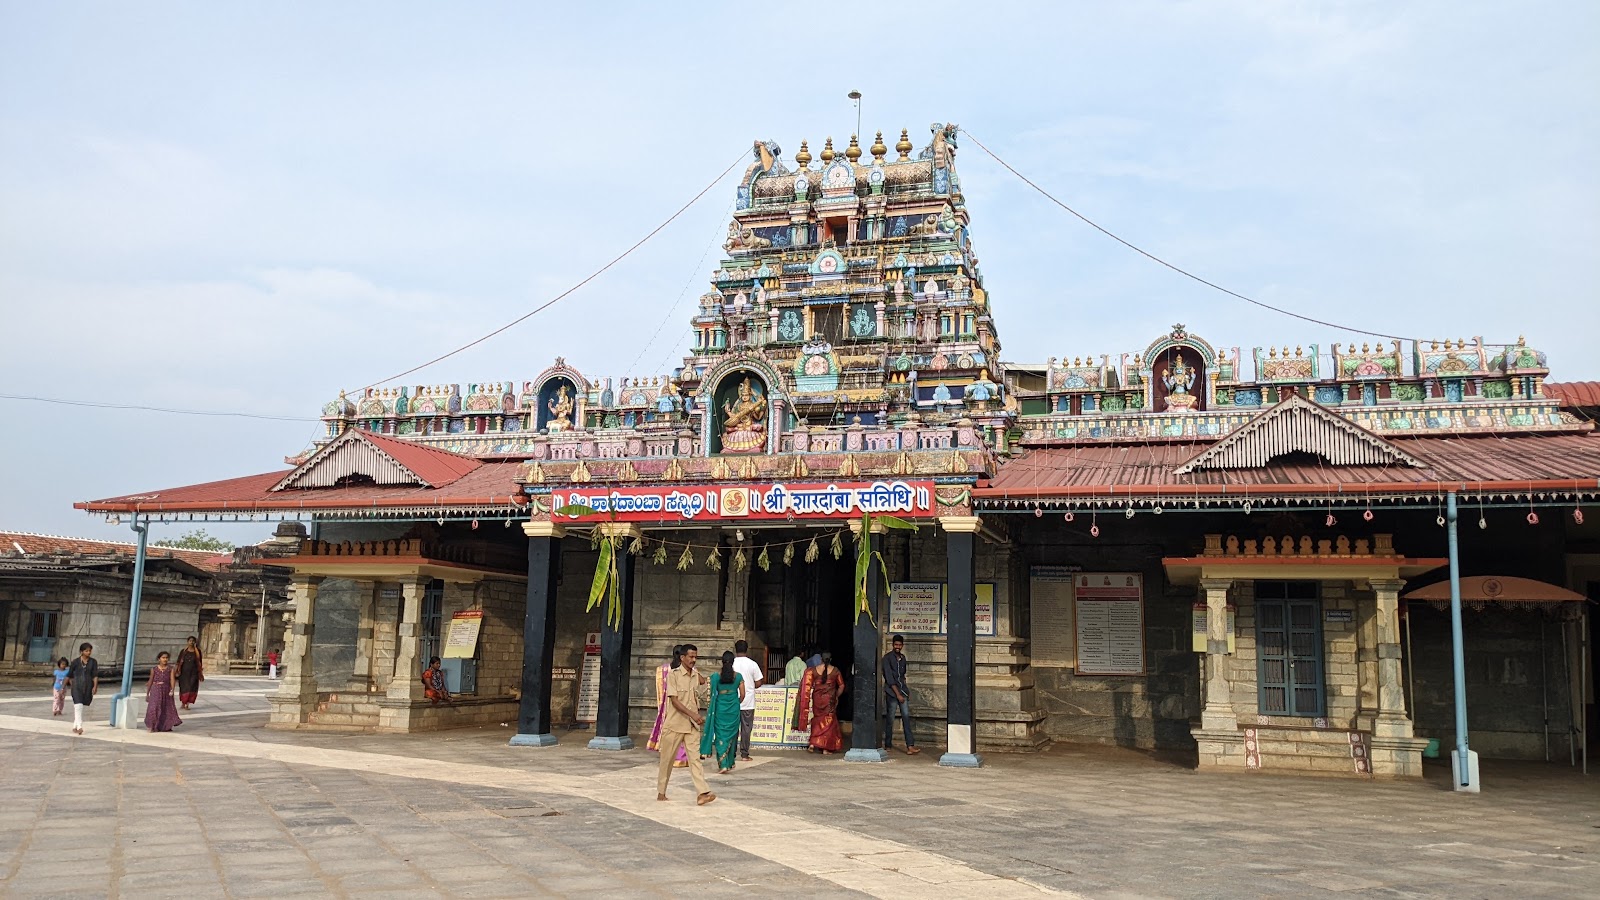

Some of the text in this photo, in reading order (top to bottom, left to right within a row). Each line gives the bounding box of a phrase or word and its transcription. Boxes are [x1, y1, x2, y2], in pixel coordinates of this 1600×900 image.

[665, 491, 704, 518] ಸನ್ನಿಧಿ
[764, 485, 787, 512] श्री
[790, 485, 852, 512] शारदांबा
[856, 482, 913, 511] सन्निधि
